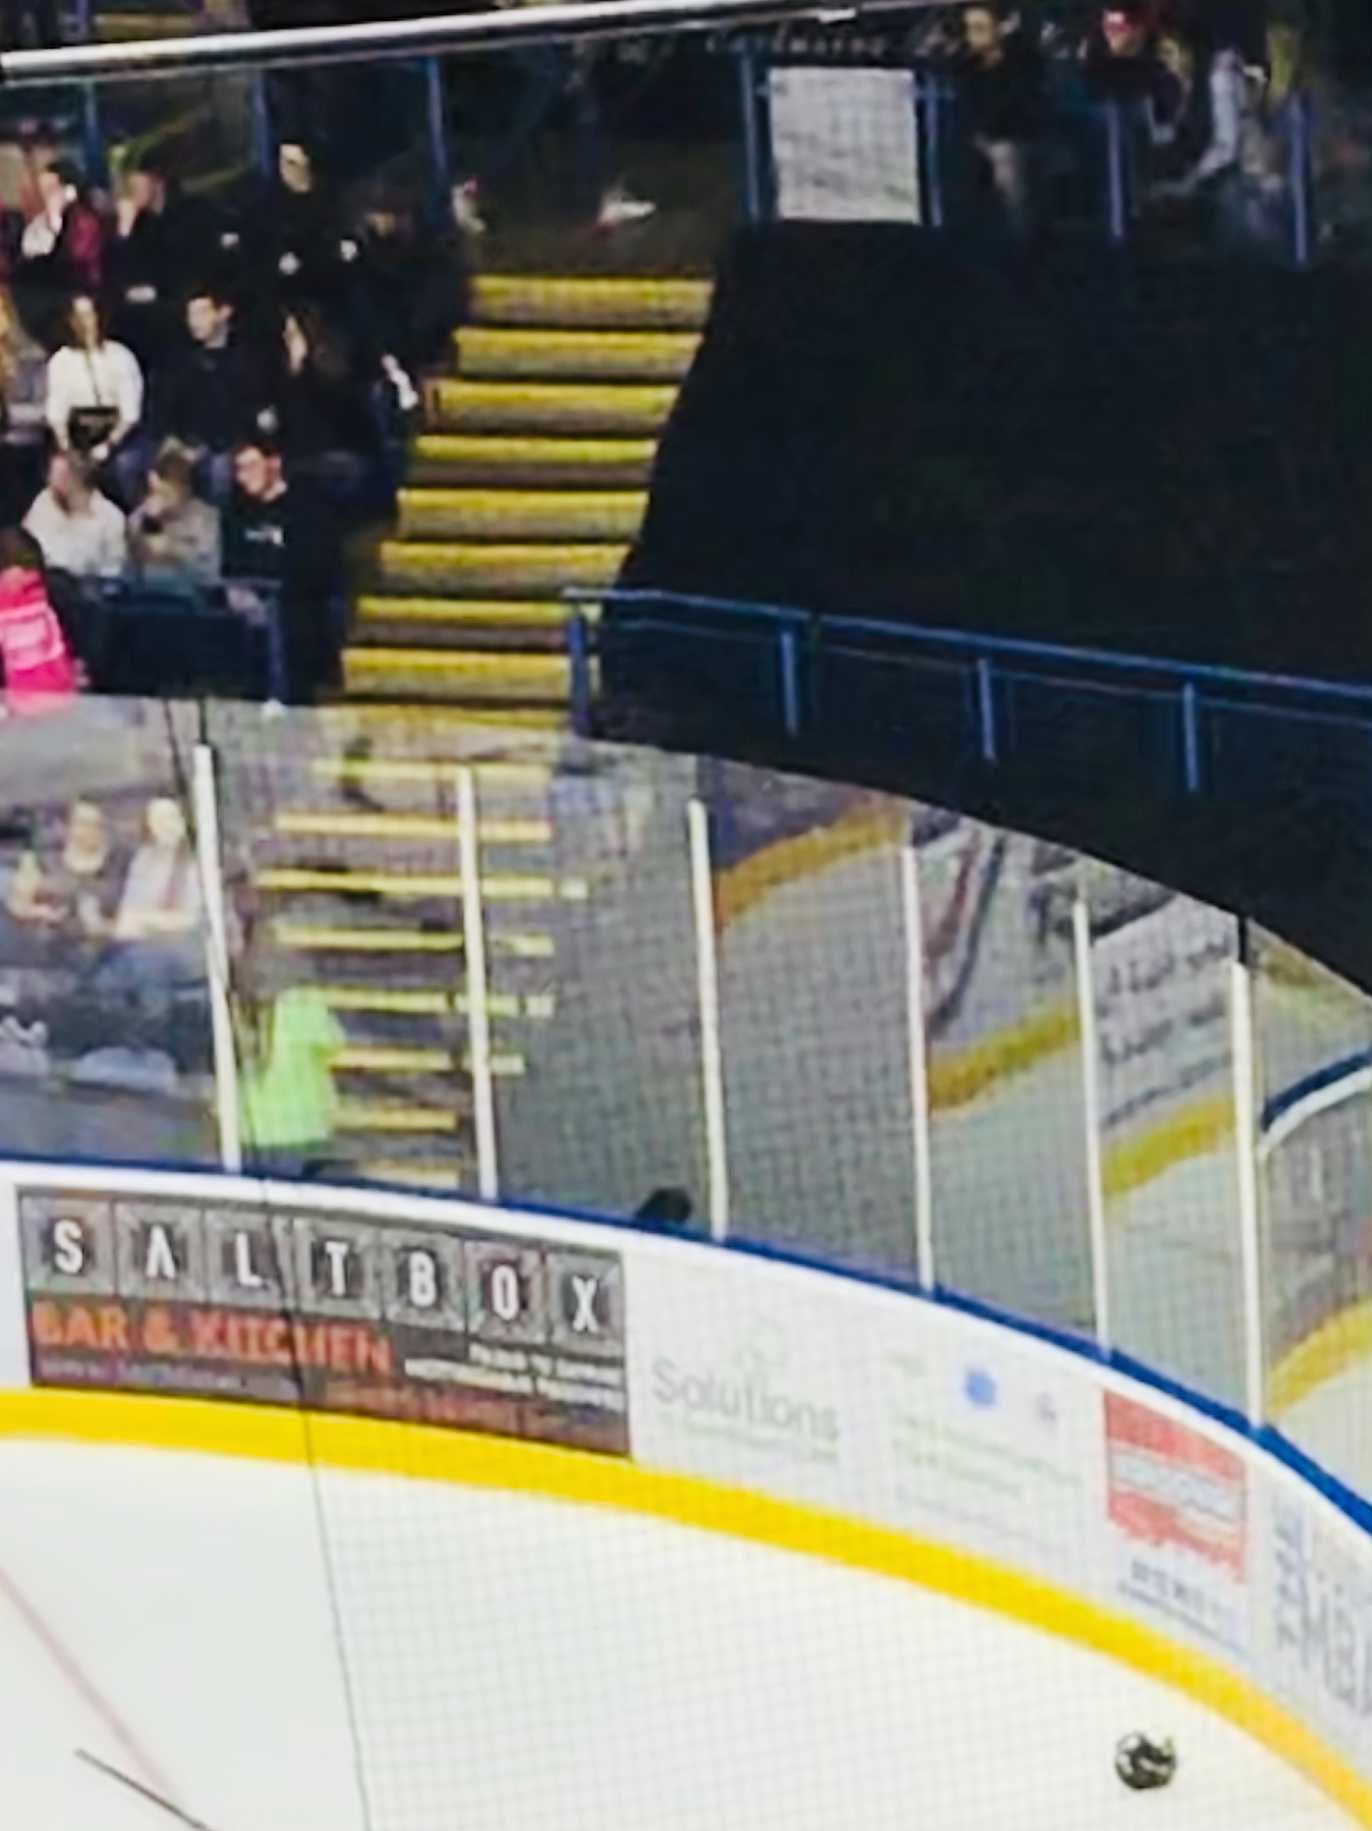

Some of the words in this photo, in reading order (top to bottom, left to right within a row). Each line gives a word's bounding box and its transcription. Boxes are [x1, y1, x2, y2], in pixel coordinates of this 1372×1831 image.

[51, 1215, 602, 1334] SALTBOX
[31, 1299, 128, 1348] BAR
[144, 1304, 180, 1353] &
[190, 1308, 394, 1376] KITCHEN
[652, 1355, 839, 1442] Solutions
